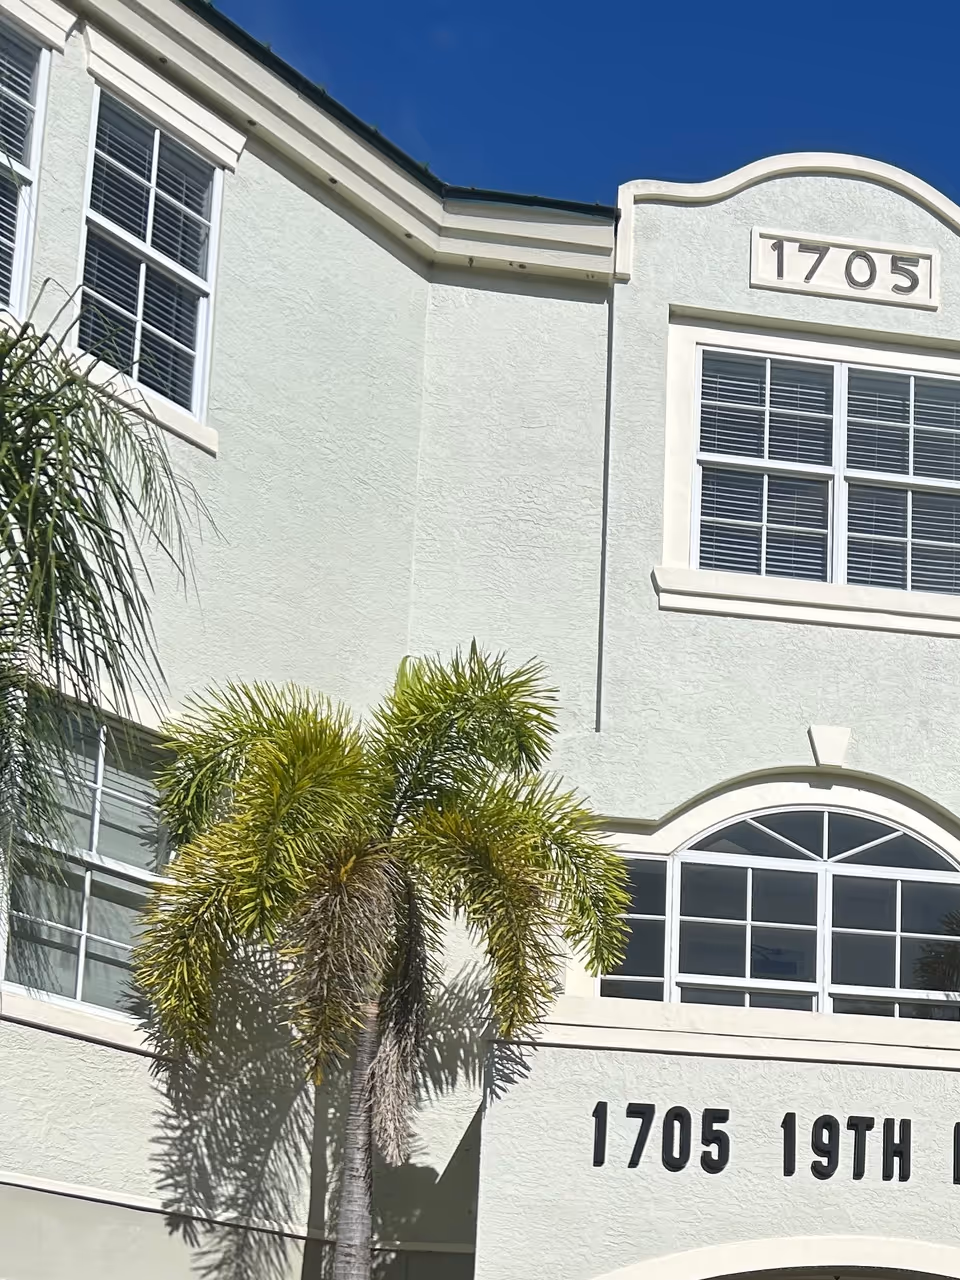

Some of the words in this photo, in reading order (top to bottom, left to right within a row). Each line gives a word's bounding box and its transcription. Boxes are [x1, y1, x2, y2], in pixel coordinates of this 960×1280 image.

[770, 240, 919, 295] 1705
[592, 1101, 730, 1174] 1705
[781, 1112, 911, 1181] 19TH
